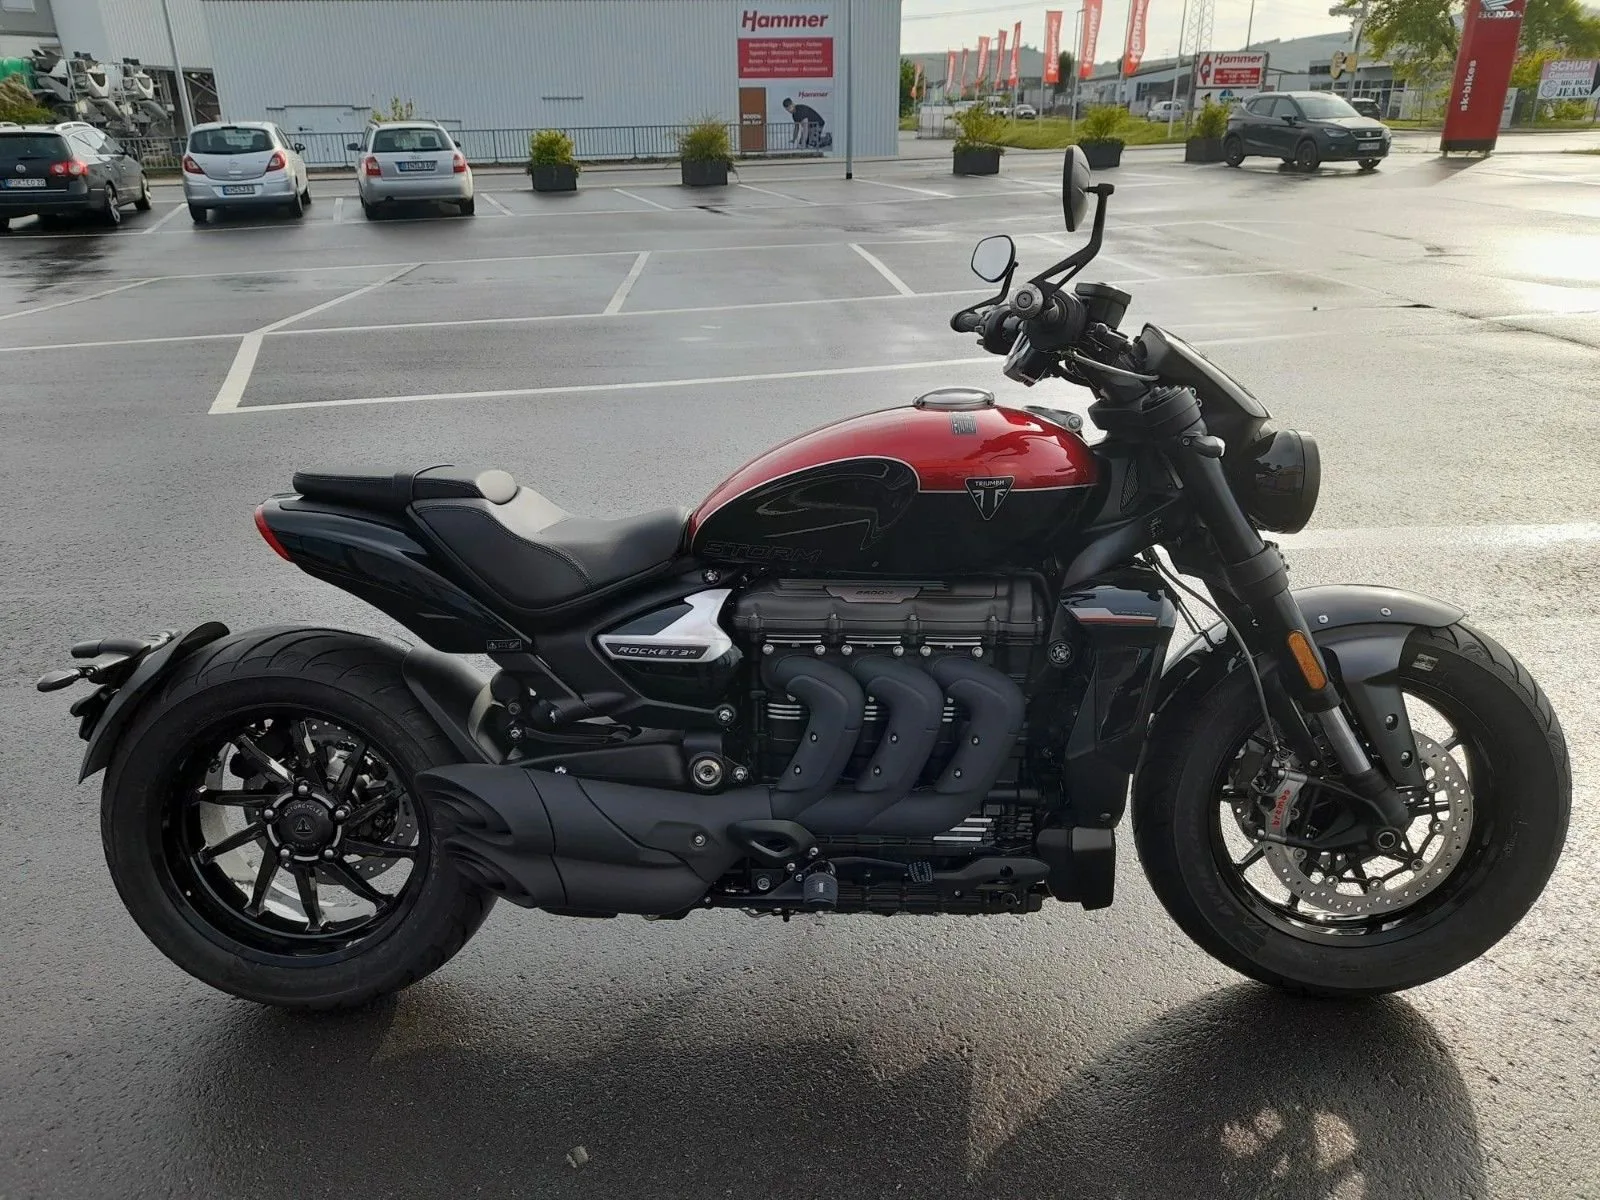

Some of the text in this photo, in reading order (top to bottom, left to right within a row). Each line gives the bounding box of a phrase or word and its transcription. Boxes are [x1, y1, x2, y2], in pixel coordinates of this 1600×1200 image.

[1477, 10, 1523, 18] HONDA
[741, 10, 829, 32] Hammer
[1083, 4, 1099, 68] Hammer
[1128, 0, 1144, 63] Hamme
[1214, 53, 1263, 65] Hammer
[1550, 60, 1592, 70] SCHUH
[798, 91, 828, 99] Hammer
[1556, 86, 1590, 97] JEANS
[703, 540, 823, 563] STORM
[617, 646, 679, 656] ROCKET
[284, 803, 324, 818] MOTORCYCLES
[1271, 789, 1291, 827] brembo
